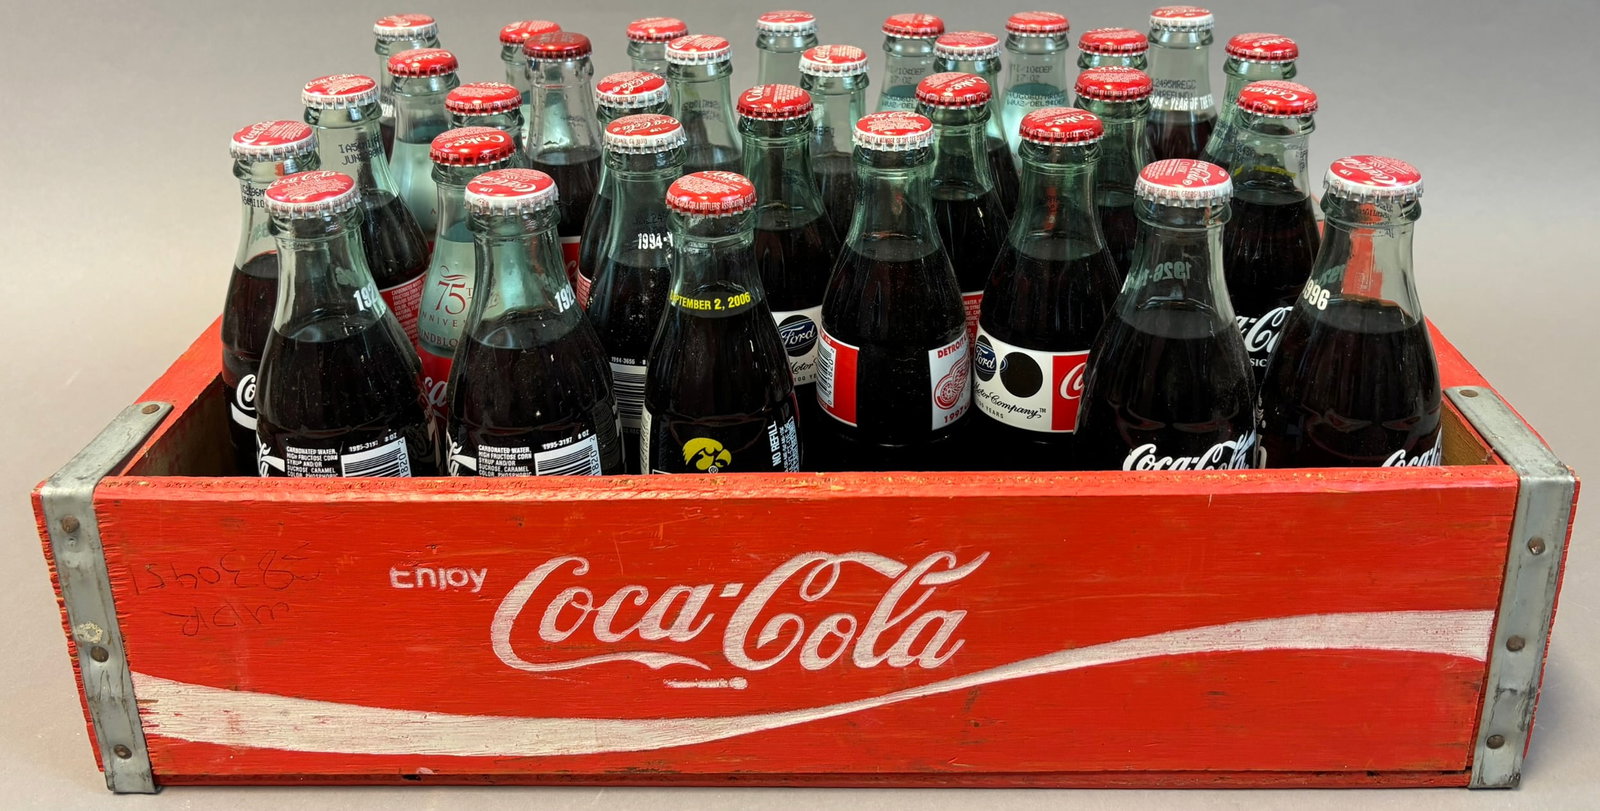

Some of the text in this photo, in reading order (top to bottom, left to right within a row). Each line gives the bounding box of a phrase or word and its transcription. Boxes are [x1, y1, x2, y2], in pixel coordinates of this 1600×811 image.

[714, 298, 725, 311] 2,
[728, 292, 751, 308] 2006
[781, 324, 816, 345] Ford
[976, 346, 995, 369] Ford
[286, 446, 317, 455] CARBONATED
[478, 445, 510, 454] CARBONATED
[767, 420, 782, 467] NO REFILL
[390, 550, 991, 672] Enjoy Coca-Cola
